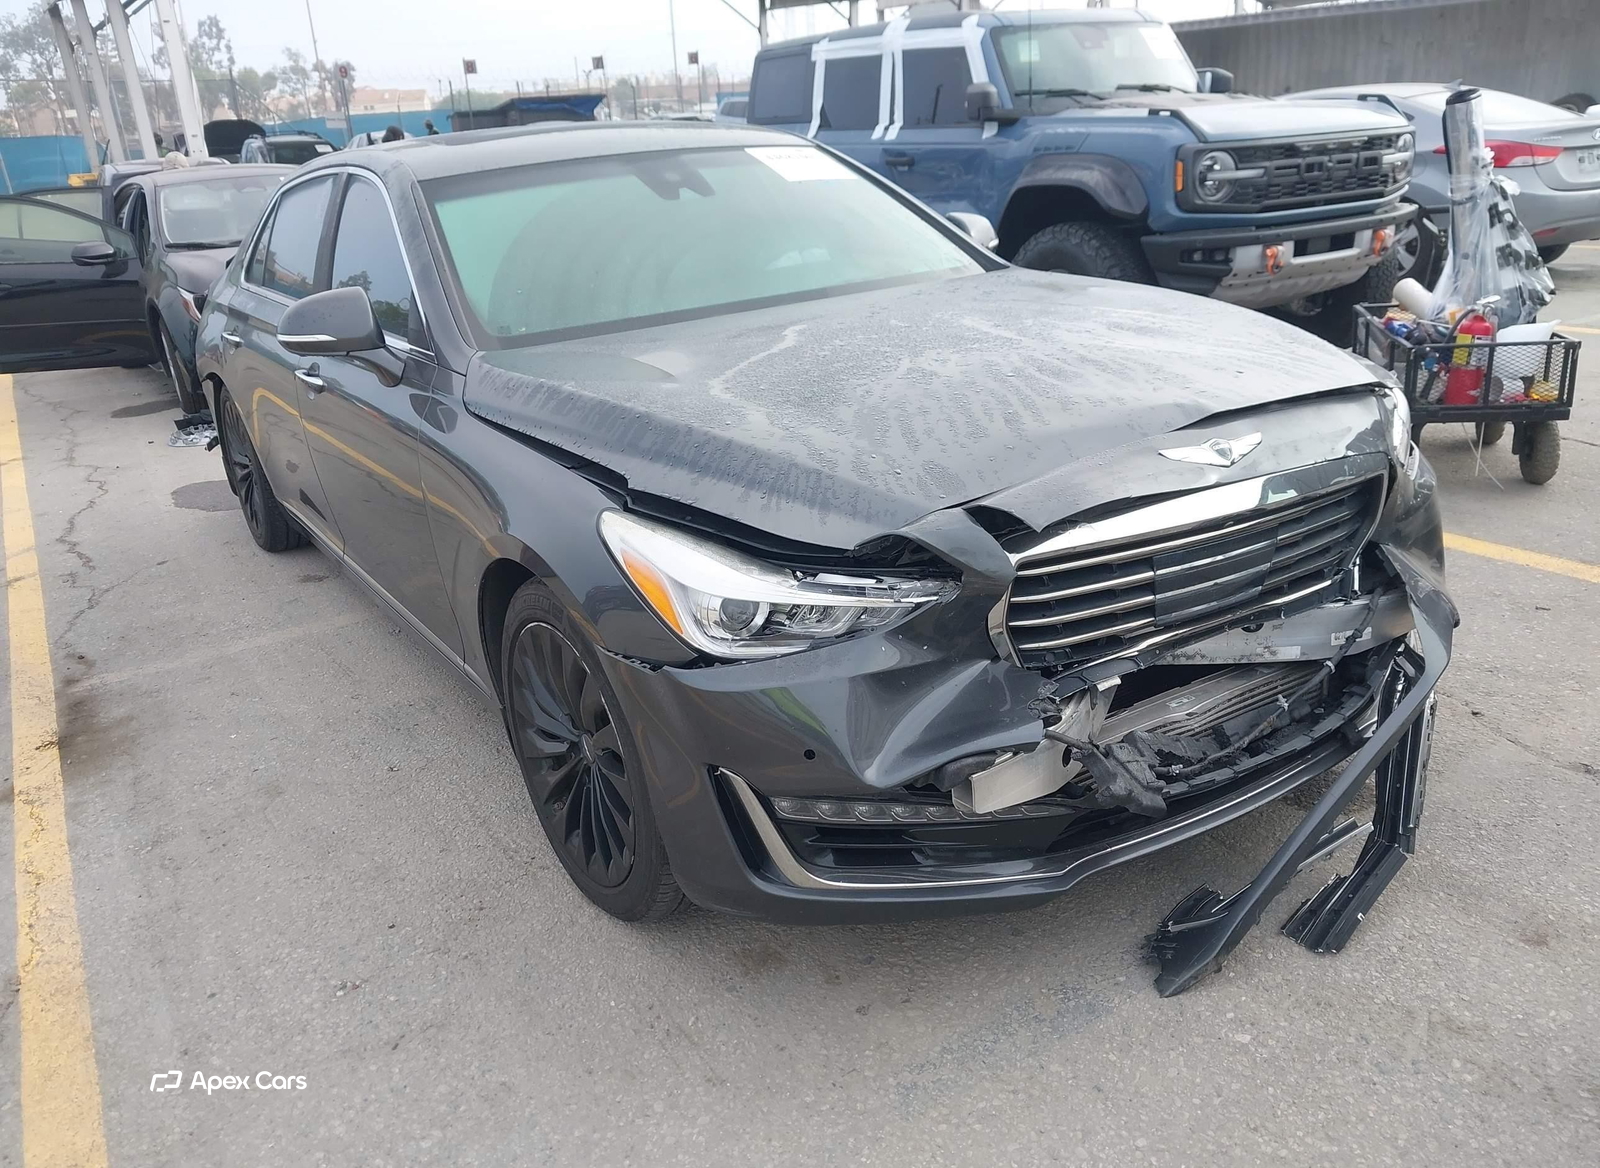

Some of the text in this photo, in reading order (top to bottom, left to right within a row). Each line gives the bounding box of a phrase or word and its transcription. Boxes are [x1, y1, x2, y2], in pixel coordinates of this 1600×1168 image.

[339, 65, 348, 78] 9
[466, 61, 475, 73] 8
[1269, 152, 1382, 182] FORD
